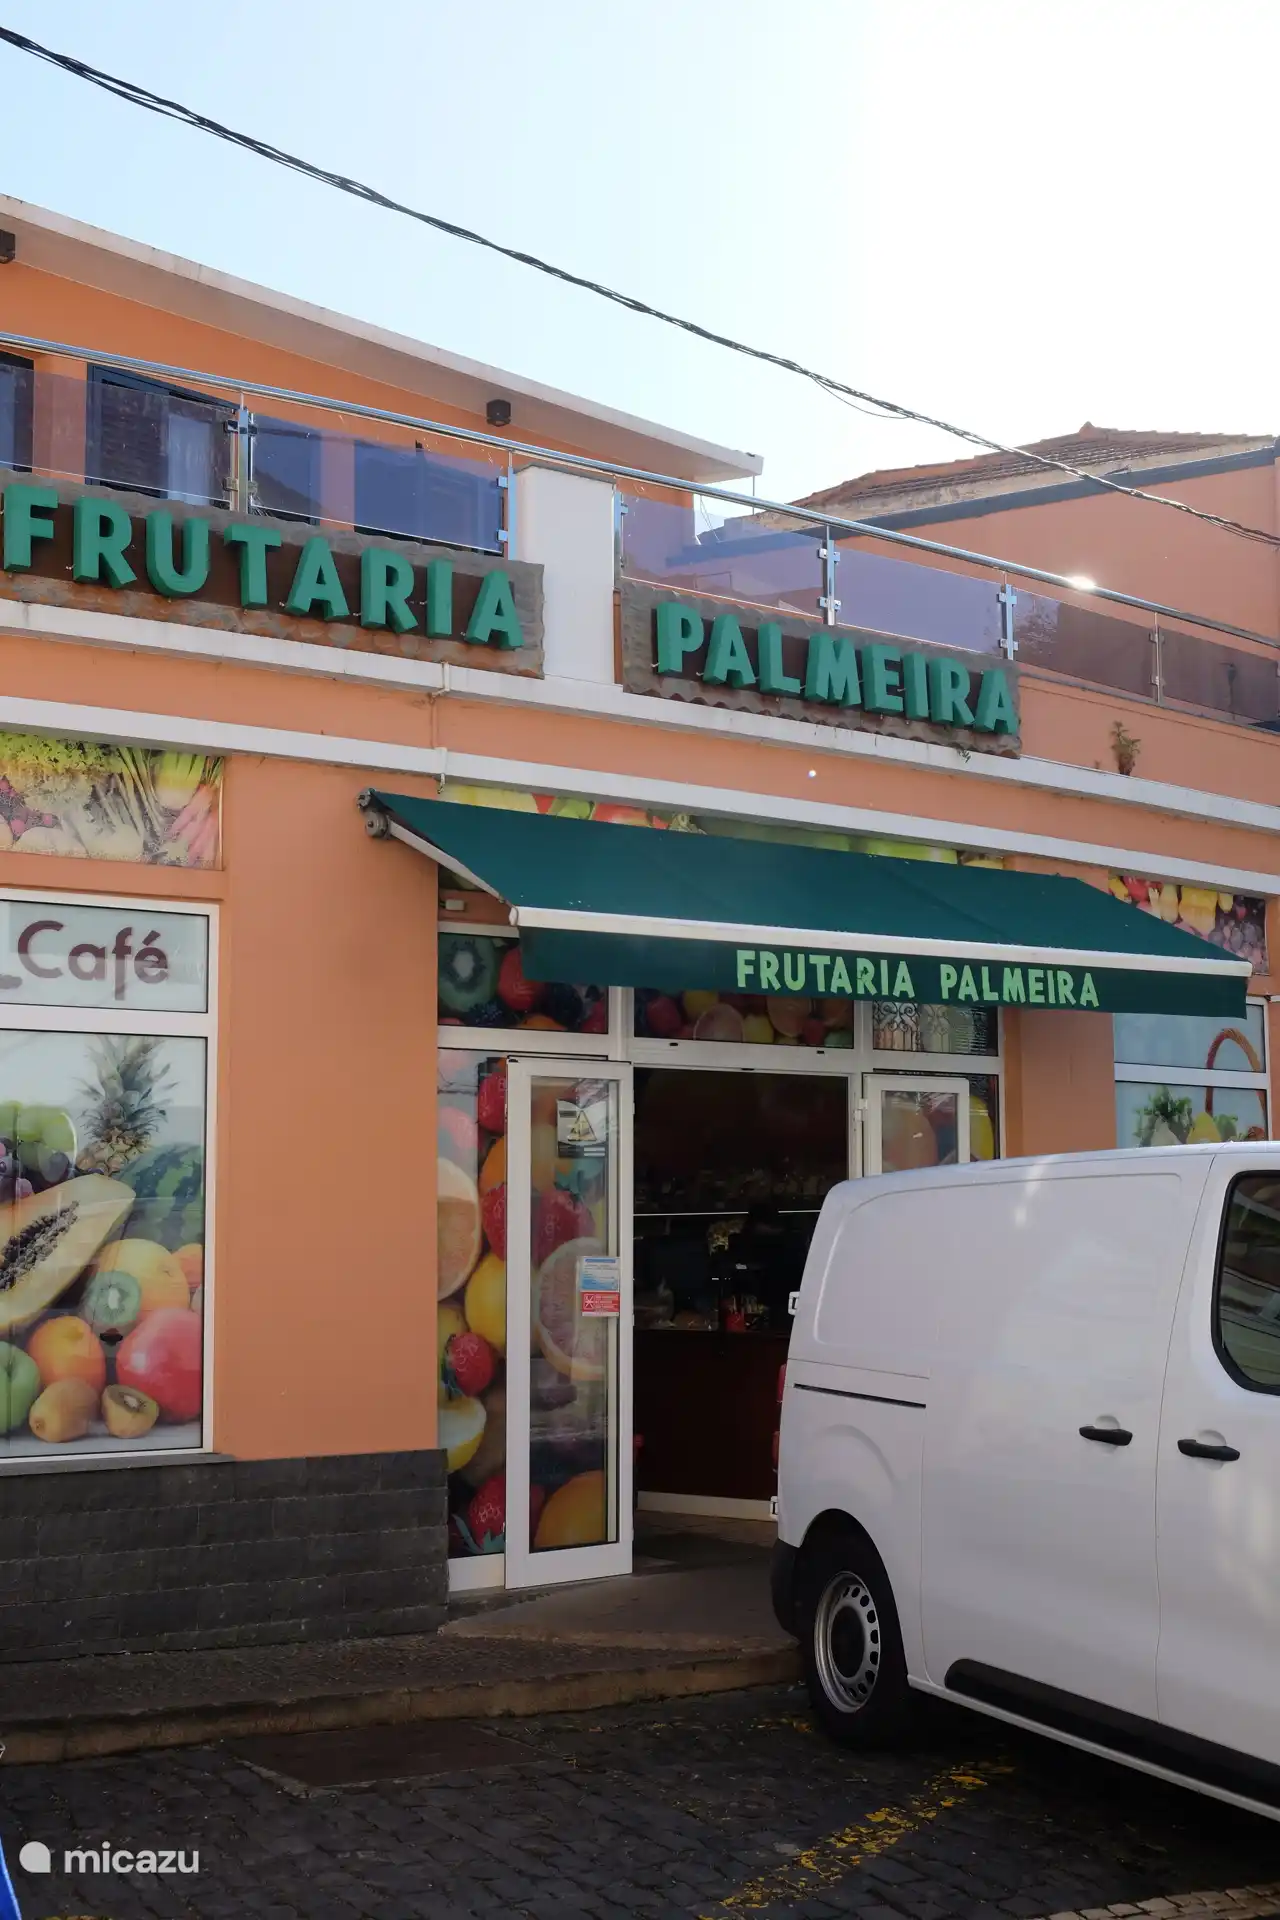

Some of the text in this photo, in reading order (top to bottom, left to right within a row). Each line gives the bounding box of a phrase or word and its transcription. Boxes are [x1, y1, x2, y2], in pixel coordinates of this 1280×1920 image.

[2, 484, 524, 650] FRUTARIA
[657, 601, 1018, 735] PALMEIRA
[18, 920, 168, 1001] Café
[737, 949, 1100, 1008] FRUTARIA PALMEIRA
